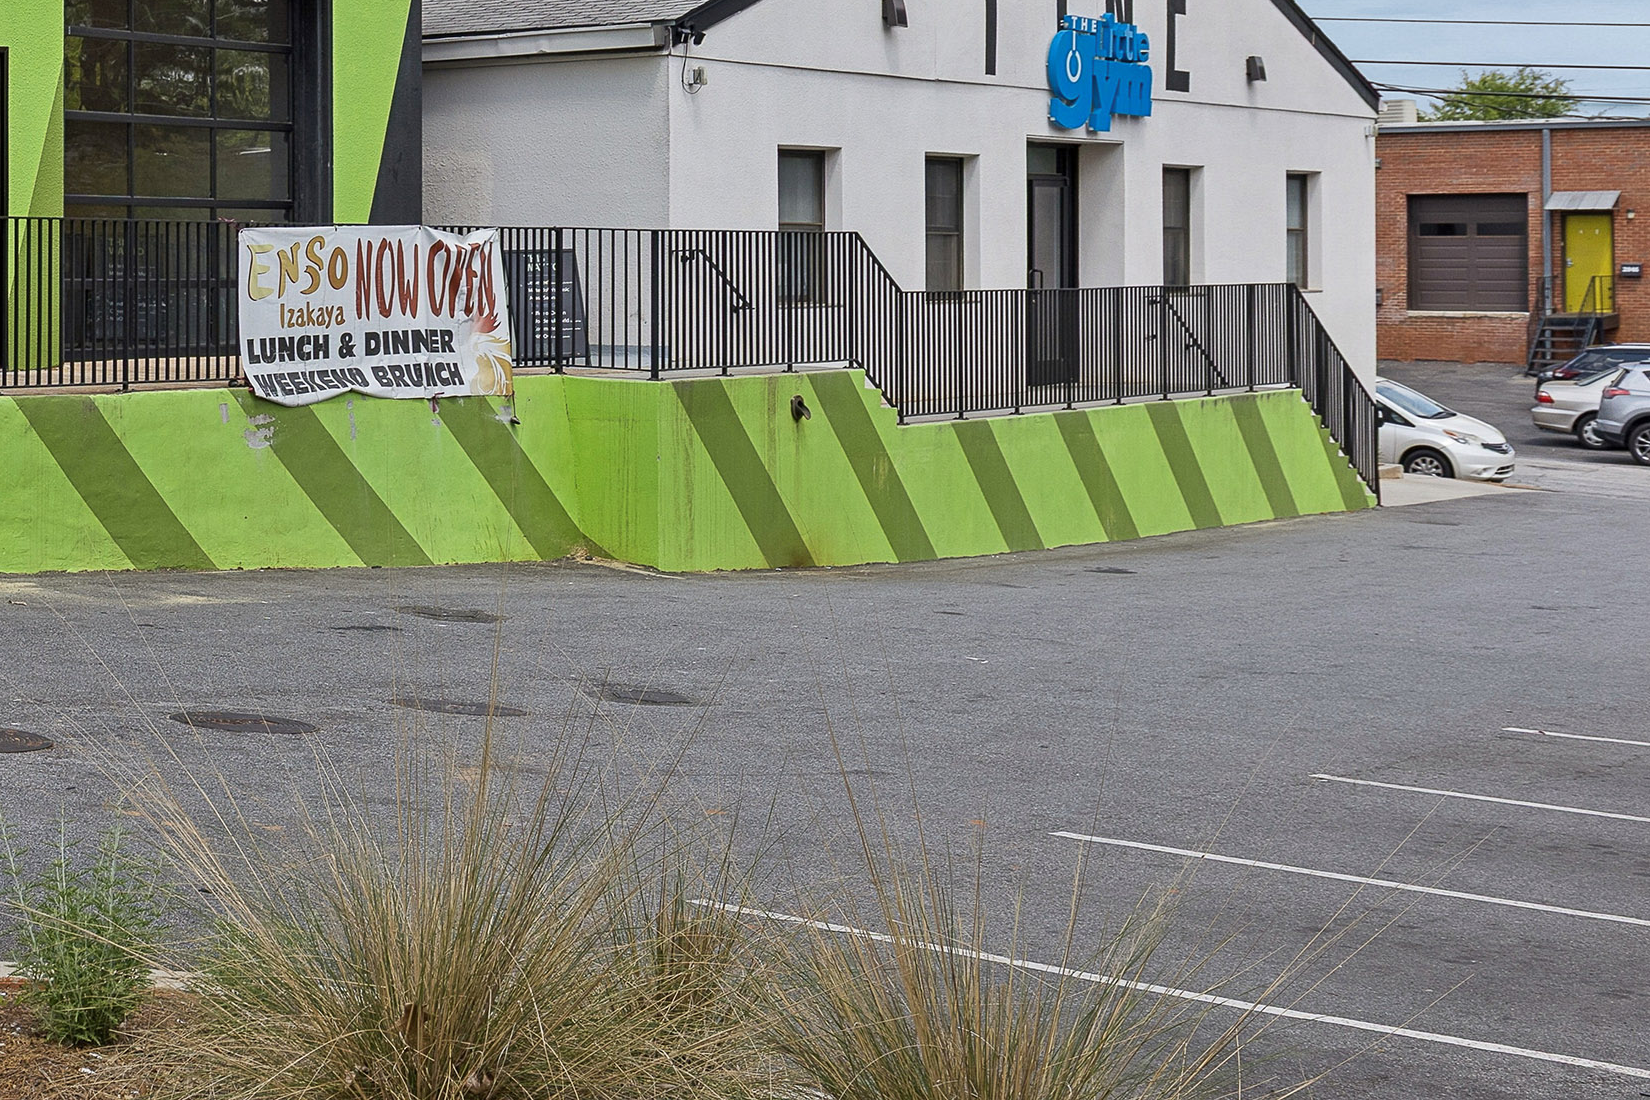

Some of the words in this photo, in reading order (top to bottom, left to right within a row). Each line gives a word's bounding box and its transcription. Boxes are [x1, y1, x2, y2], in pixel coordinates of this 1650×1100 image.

[1071, 16, 1098, 33] THE
[1047, 30, 1153, 132] gym
[247, 235, 349, 301] ENSO
[355, 237, 419, 320] NOW
[427, 238, 499, 322] OPEN
[279, 302, 346, 329] Izakaya
[246, 330, 330, 364] LUNCH
[338, 332, 357, 359] &
[364, 329, 456, 357] DINNER
[253, 367, 369, 398] WEEKEND
[370, 362, 465, 389] BRUNCH
